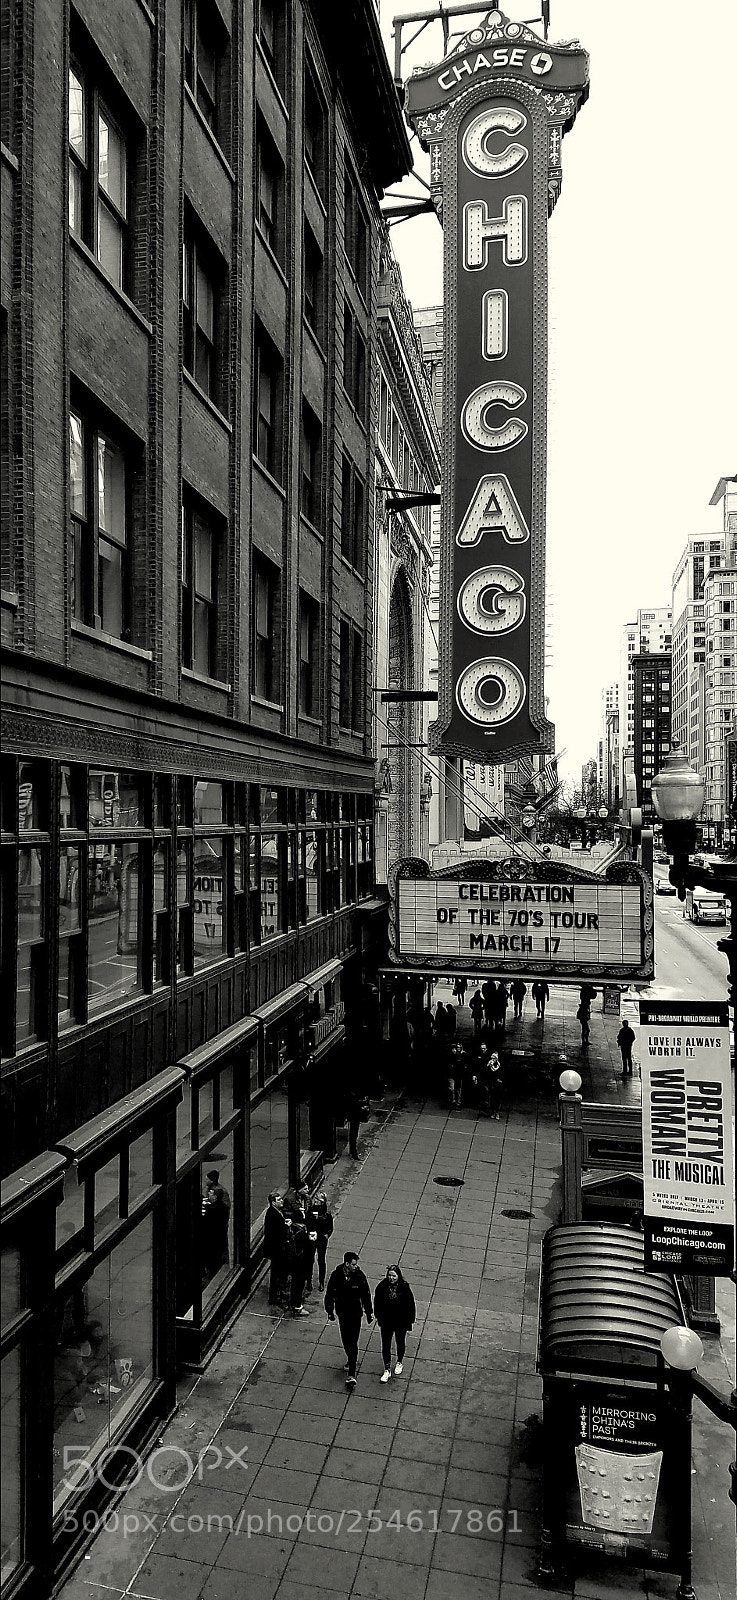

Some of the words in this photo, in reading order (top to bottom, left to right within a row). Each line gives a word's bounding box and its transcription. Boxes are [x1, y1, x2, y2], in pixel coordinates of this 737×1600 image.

[437, 48, 527, 91] CHASE
[455, 106, 529, 727] CHICAGO
[458, 884, 575, 903] CELEBRATION
[436, 908, 459, 924] OF
[468, 908, 501, 926] THE
[508, 910, 544, 927] 70'S
[551, 912, 599, 929] TOUR
[470, 933, 533, 952] MARCH
[544, 936, 561, 953] 17
[648, 1036, 670, 1047] LOVE
[673, 1037, 682, 1047] IS
[686, 1038, 721, 1048] ALWAYS
[648, 1047, 681, 1056] WORTH
[686, 1047, 696, 1057] IT.
[650, 1068, 687, 1157] WOMAN
[686, 1080, 724, 1164] PRETTY
[652, 1159, 671, 1180] THE
[674, 1161, 726, 1186] MUSICAL
[663, 1225, 688, 1235] EXPLORE
[651, 1233, 726, 1250] LoopChicago.com
[592, 1405, 657, 1422] MIRRORING
[592, 1415, 635, 1429] CHINA'S
[592, 1424, 617, 1436] PAST
